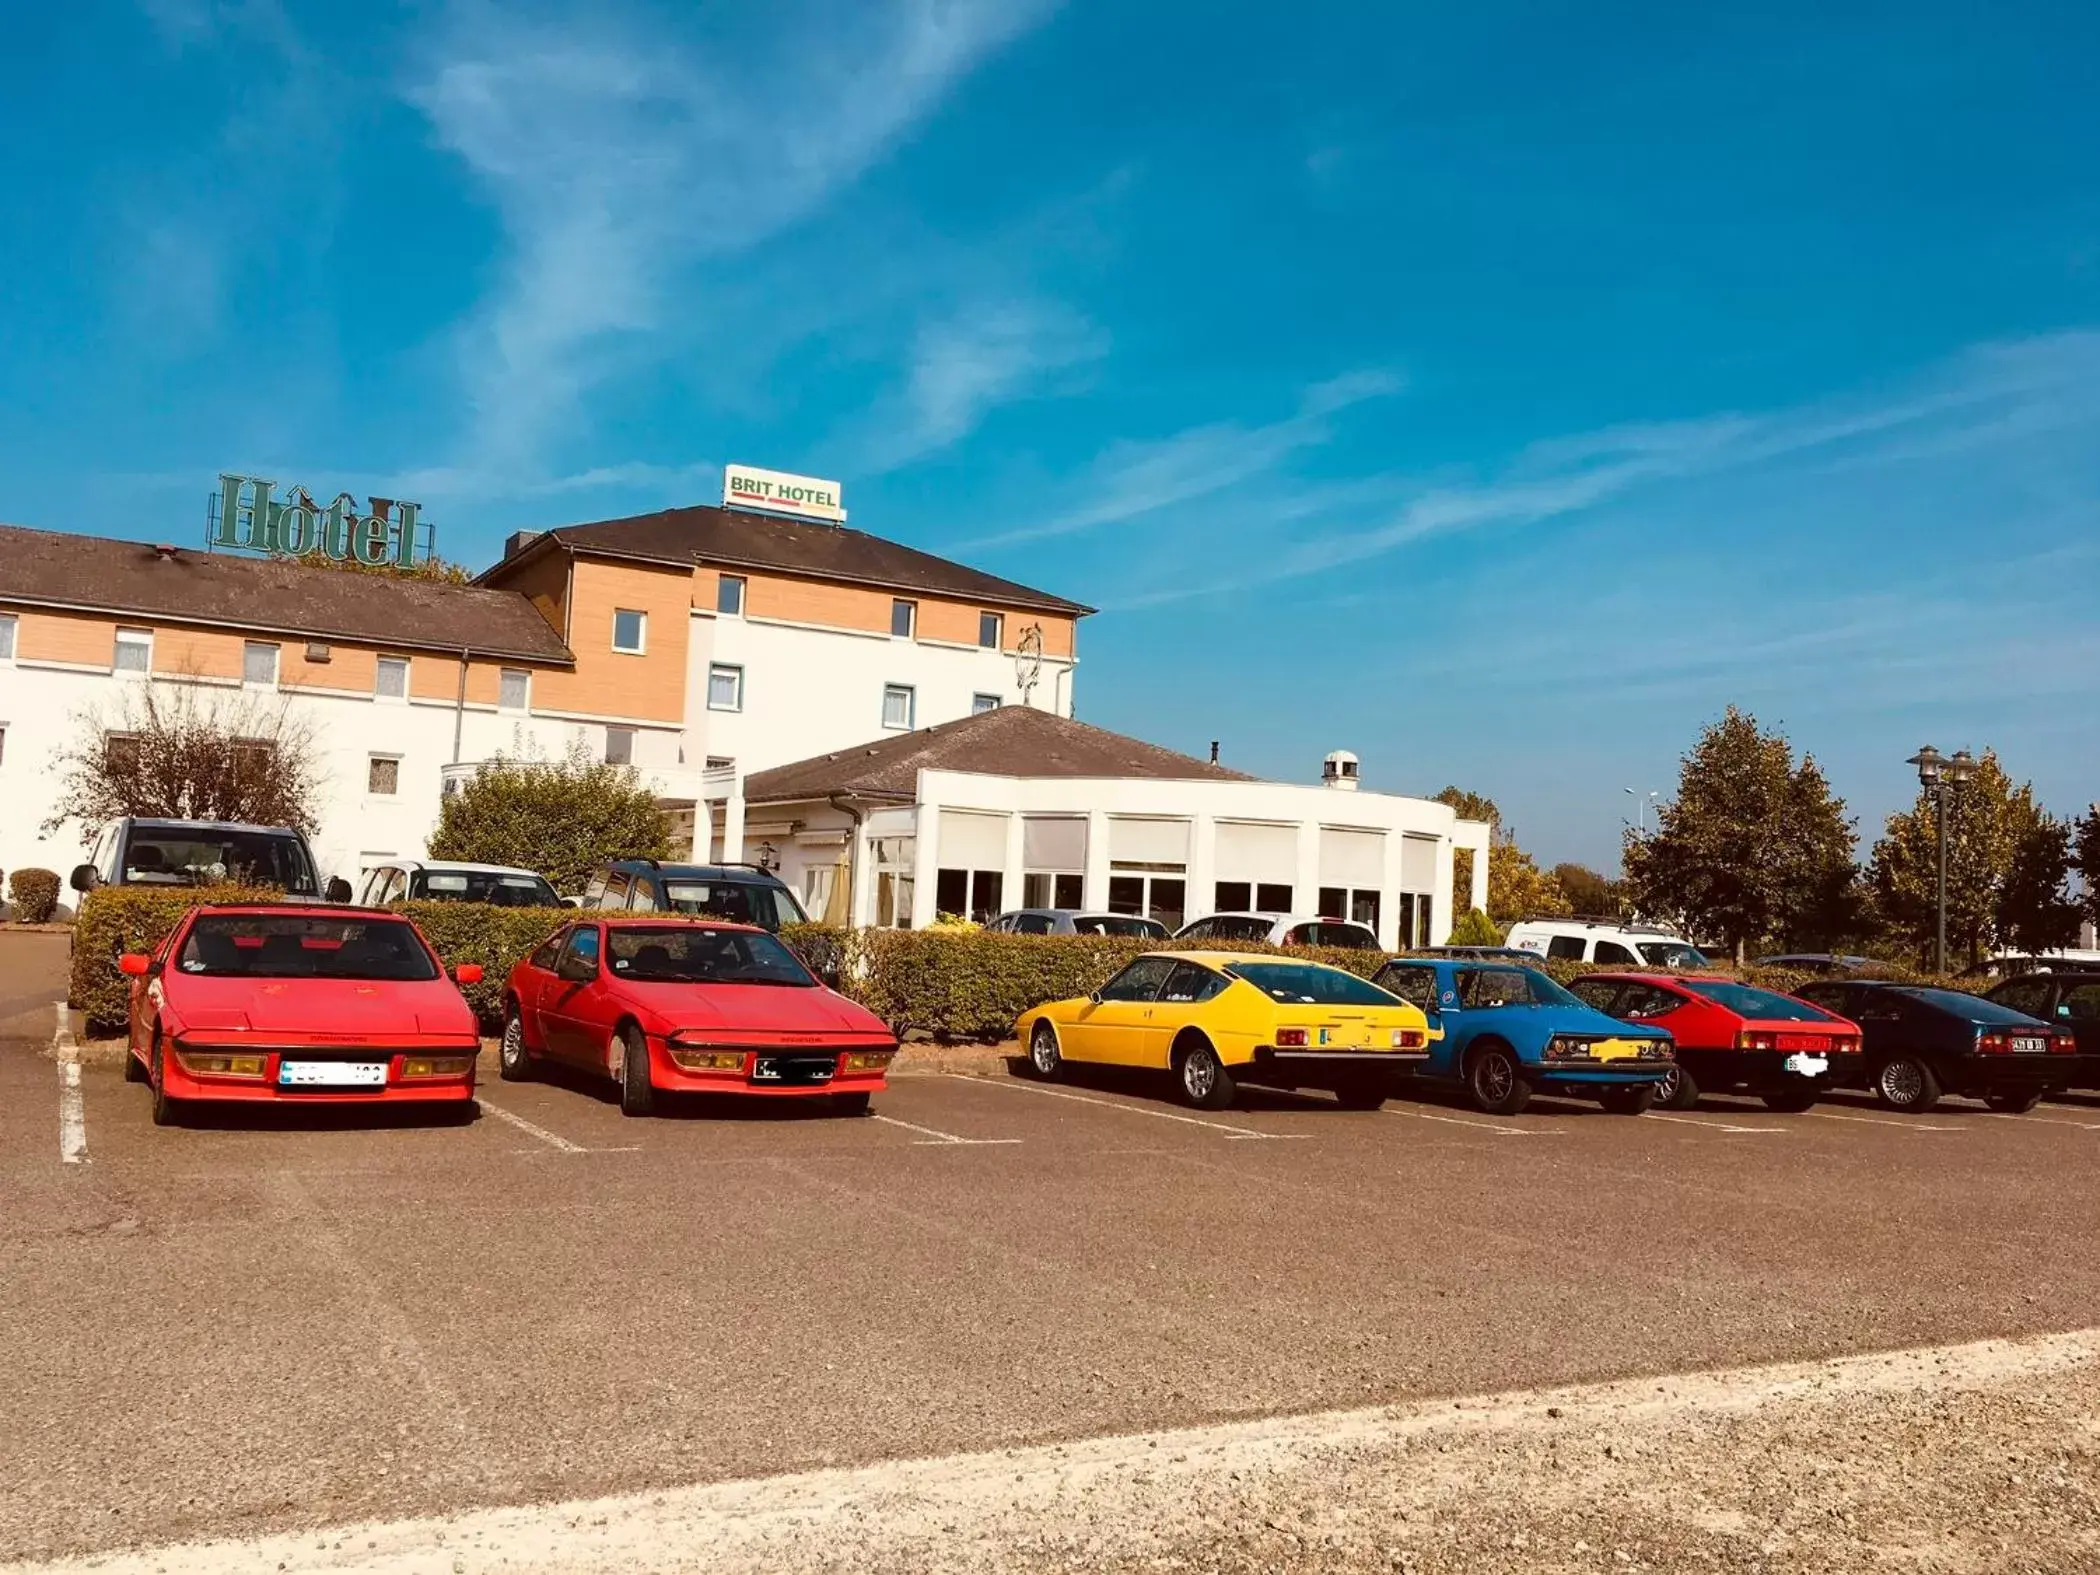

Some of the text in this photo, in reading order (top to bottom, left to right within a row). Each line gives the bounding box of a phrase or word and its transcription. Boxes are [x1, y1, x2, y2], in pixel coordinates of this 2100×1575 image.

[212, 473, 422, 570] Hôtel
[731, 475, 837, 507] BRIT HOTEL
